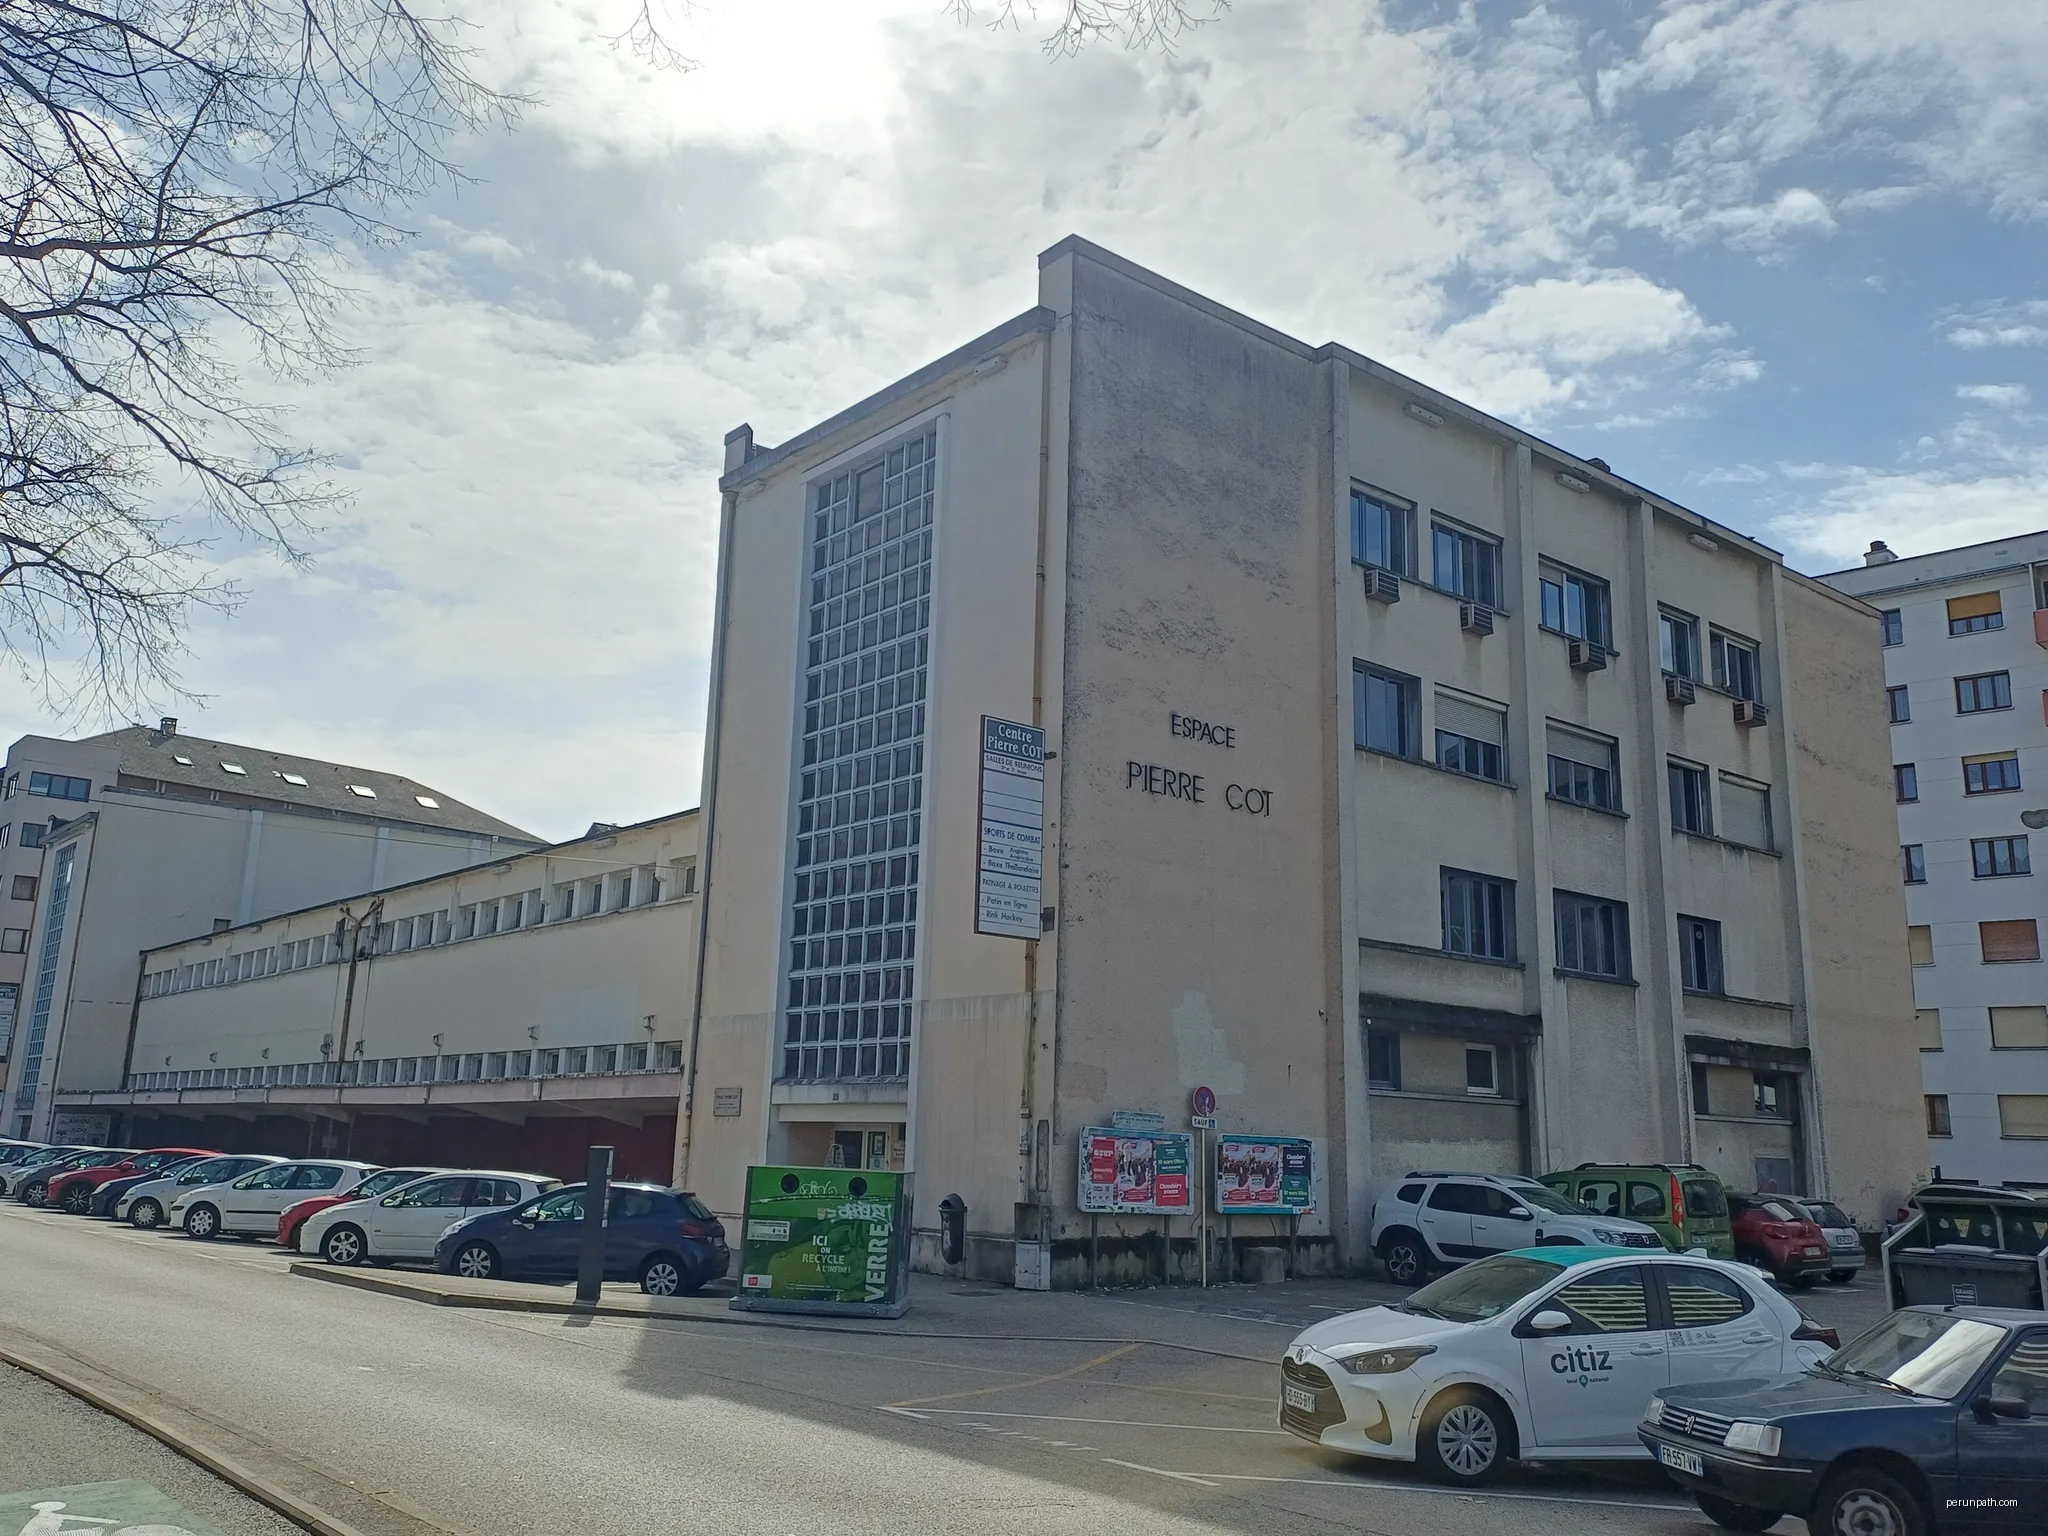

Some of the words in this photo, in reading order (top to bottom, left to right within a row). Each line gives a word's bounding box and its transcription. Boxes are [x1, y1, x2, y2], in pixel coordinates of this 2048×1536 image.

[998, 724, 1032, 743] Centre
[1171, 713, 1236, 749] ESPACE
[987, 735, 1019, 753] Pierre
[1022, 744, 1042, 758] COT
[985, 755, 1004, 765] SALLES
[1128, 761, 1205, 803] PIERRE
[1225, 784, 1274, 817] COT
[984, 826, 1005, 839] SPORTS
[1007, 831, 1015, 840] DE
[1017, 833, 1041, 845] COMBAT
[988, 845, 1004, 855] Boxe
[987, 859, 1003, 869] Boxe
[982, 878, 1006, 889] PATINAGE
[1014, 883, 1039, 894] ROULETTES
[986, 896, 1002, 906] Patin
[1004, 899, 1012, 907] en
[1013, 899, 1028, 910] ligne
[986, 910, 999, 919] Rink
[1001, 912, 1024, 924] Hockey
[1193, 1118, 1208, 1126] SAUF
[812, 1235, 828, 1247] ICI
[802, 1253, 845, 1265] RECYCLE
[864, 1222, 889, 1303] VERRE
[1955, 1288, 1975, 1296] GRAND
[1550, 1344, 1613, 1374] citiz
